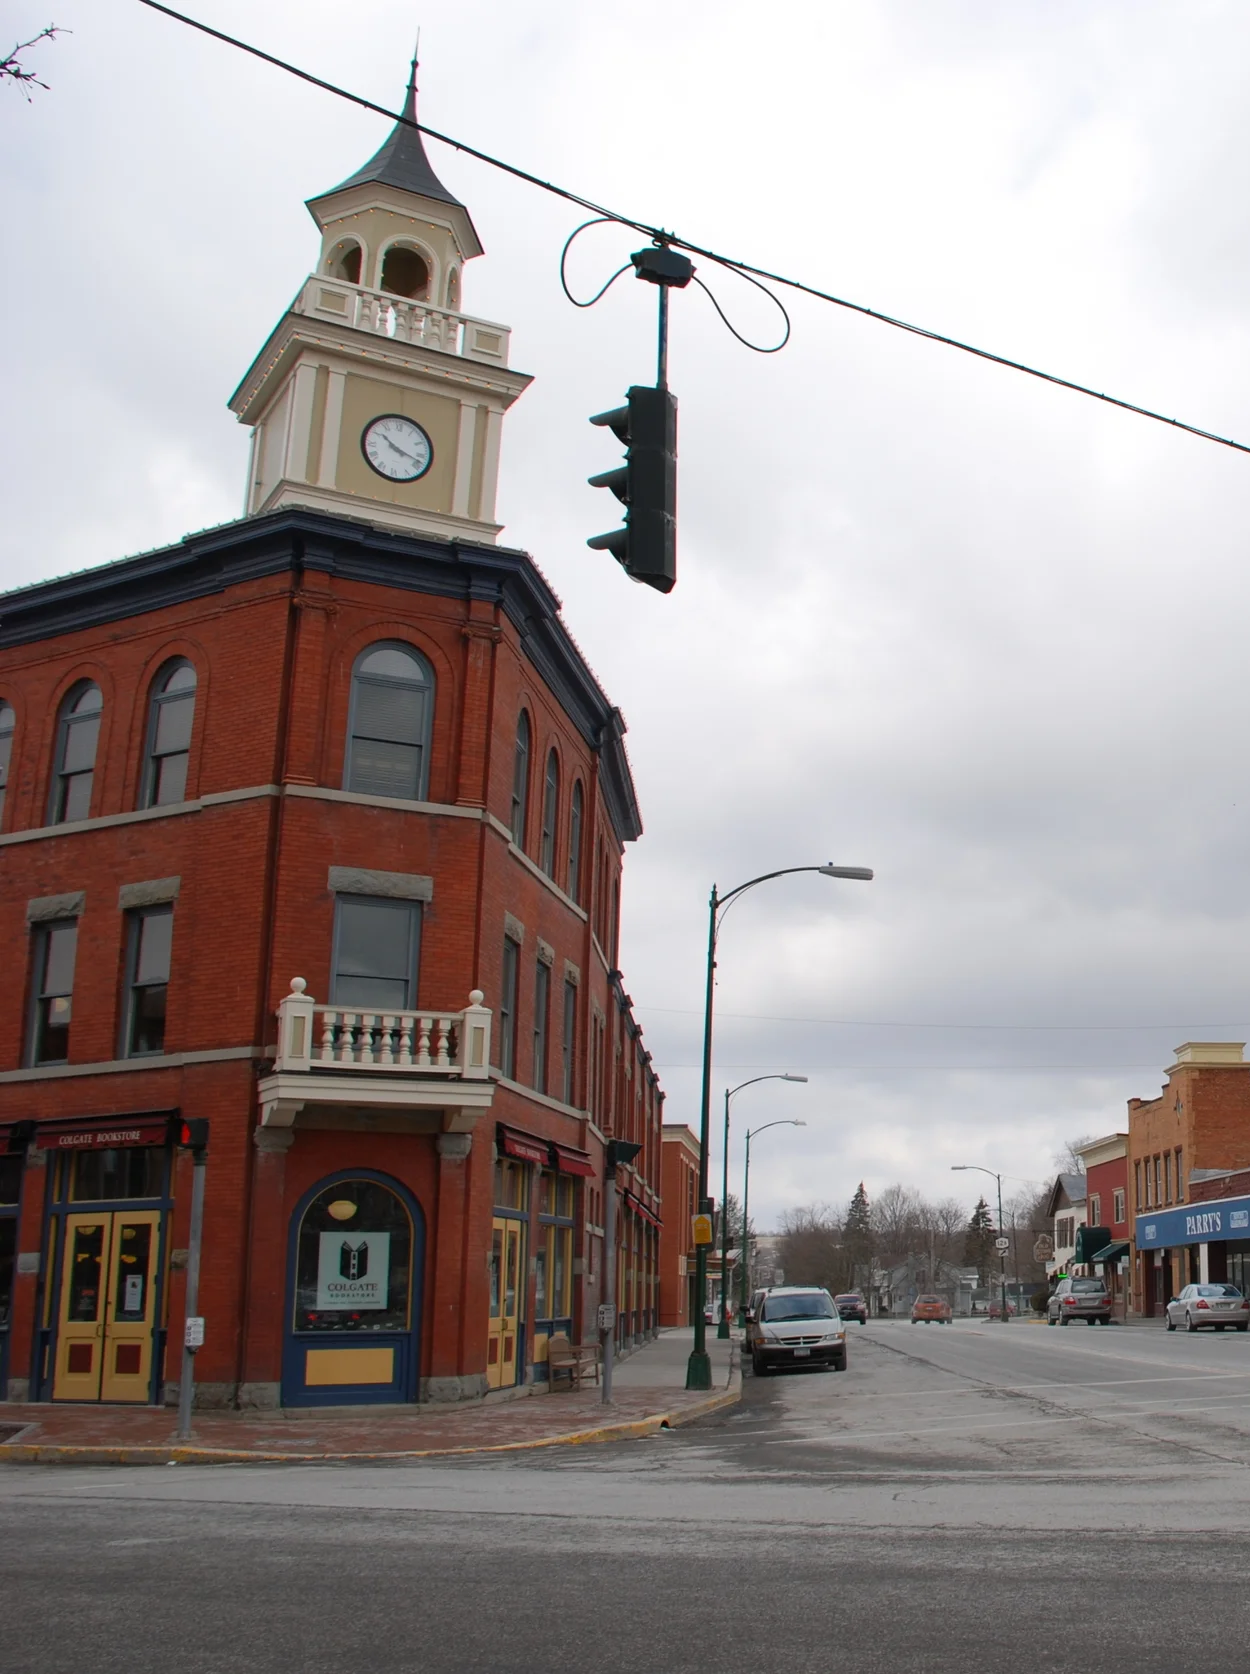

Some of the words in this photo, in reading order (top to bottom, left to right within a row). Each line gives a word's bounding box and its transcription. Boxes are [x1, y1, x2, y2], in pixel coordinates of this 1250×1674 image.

[59, 1134, 93, 1145] COLGATE
[97, 1130, 141, 1143] BOOKSTORE
[1186, 1212, 1221, 1236] PARRY'S
[327, 1283, 378, 1292] COLGATE
